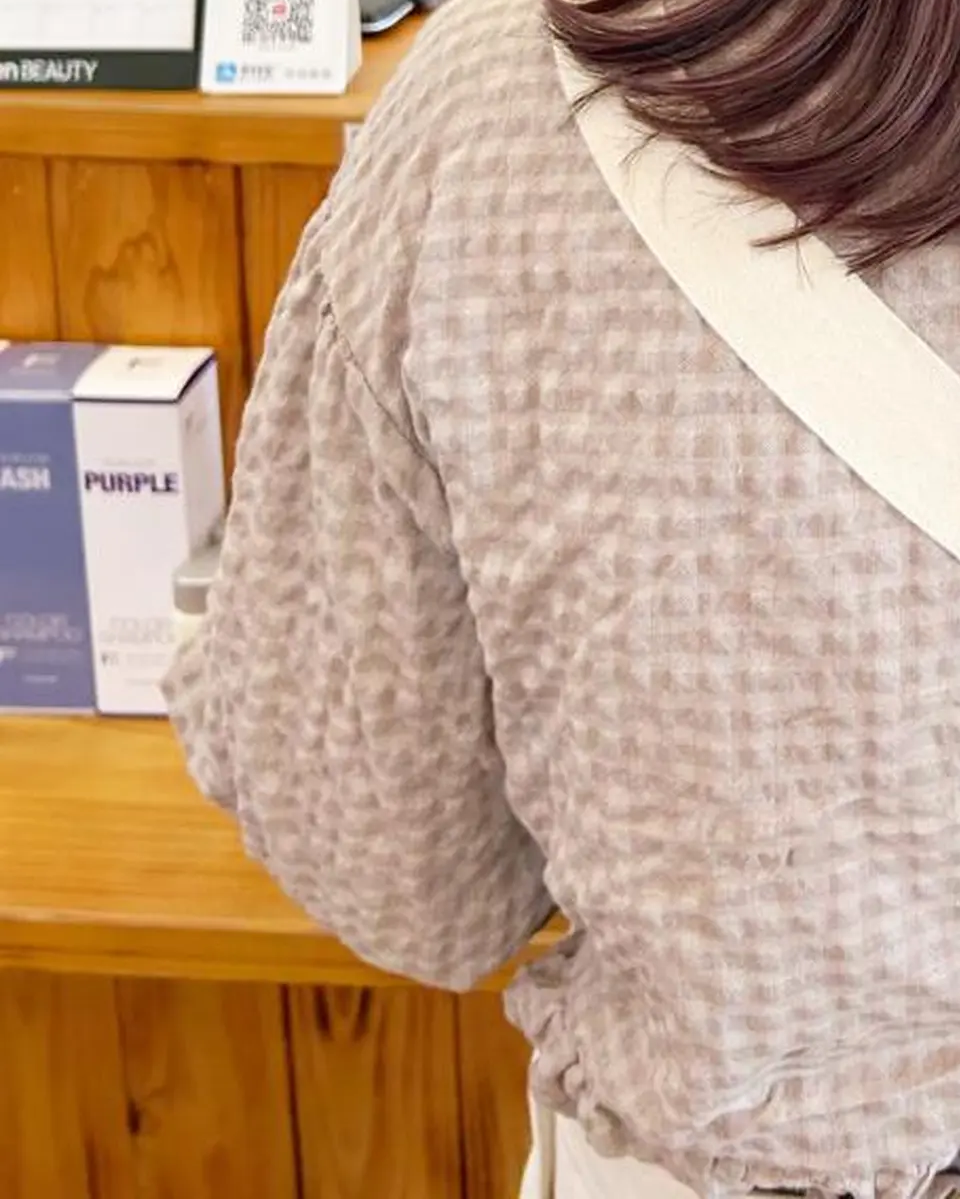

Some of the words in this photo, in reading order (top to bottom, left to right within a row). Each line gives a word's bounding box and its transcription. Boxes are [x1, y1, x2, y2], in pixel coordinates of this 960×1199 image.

[20, 58, 99, 81] BEAUTY
[0, 466, 51, 490] ASH
[84, 471, 180, 493] PURPLE
